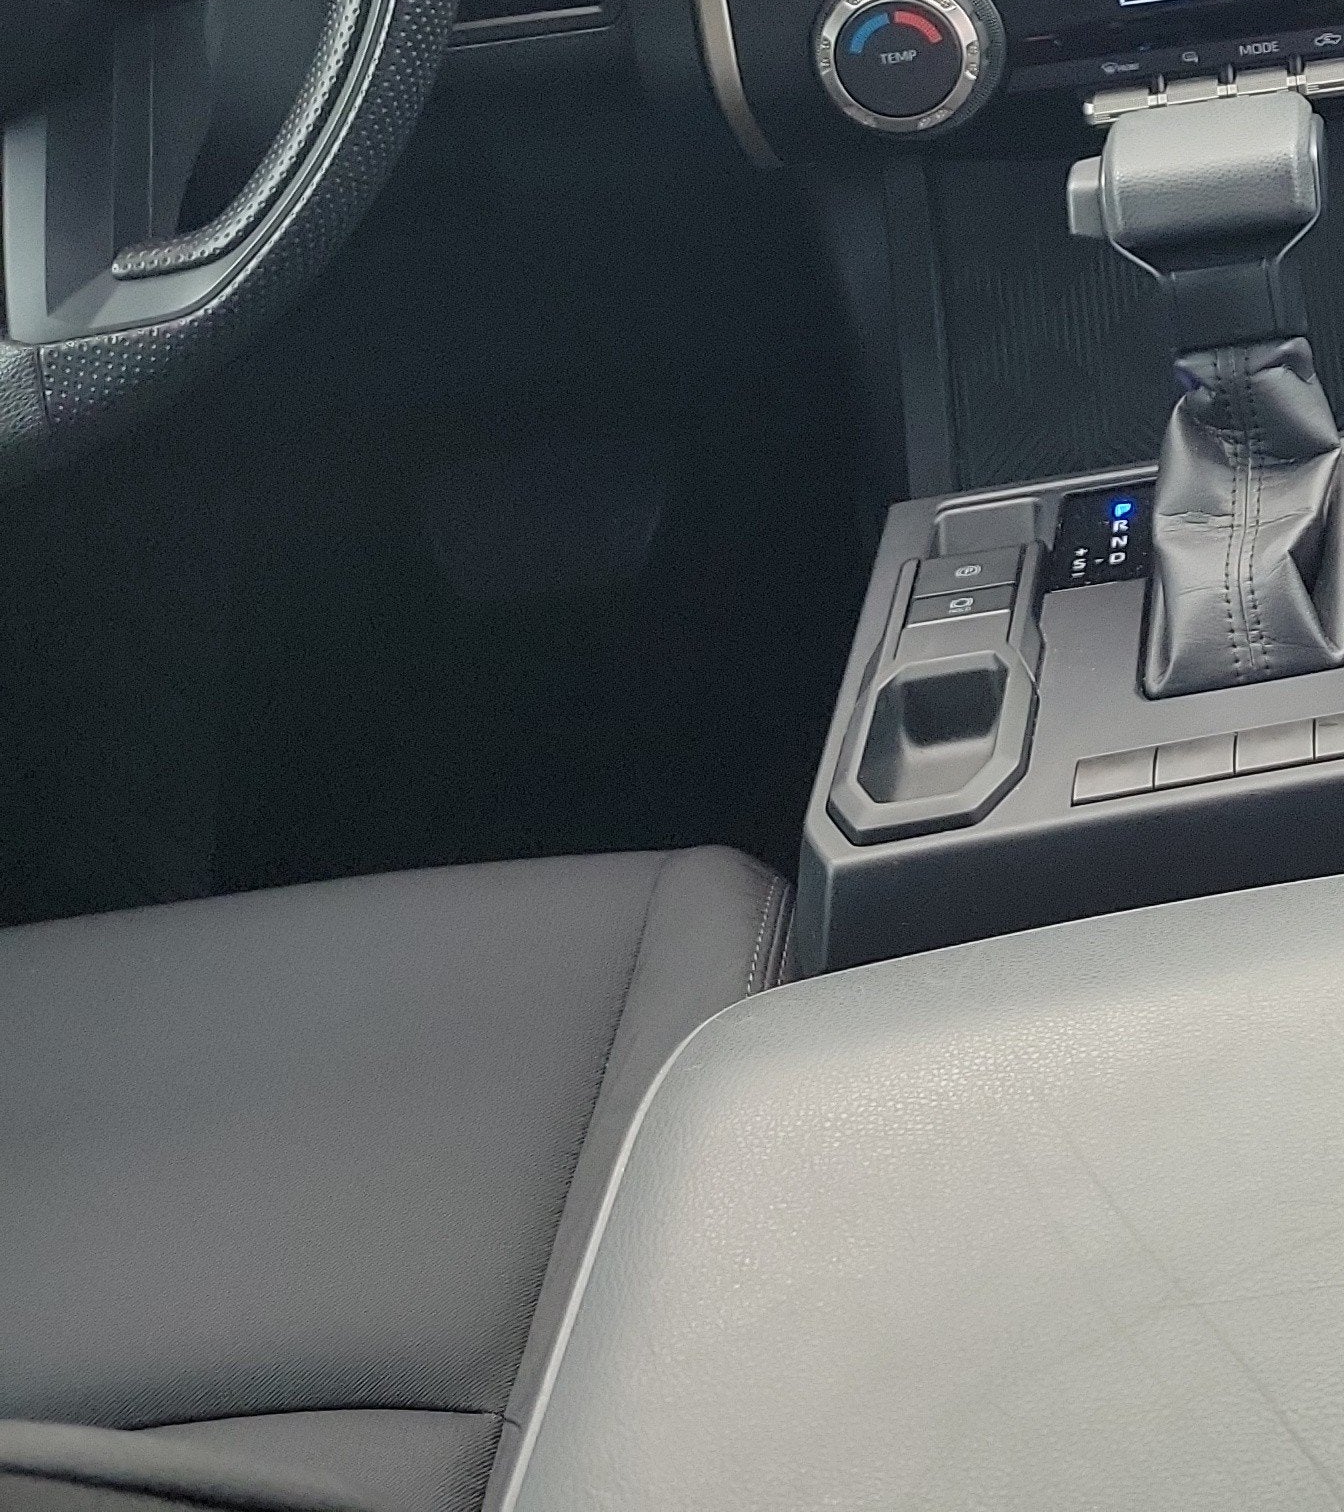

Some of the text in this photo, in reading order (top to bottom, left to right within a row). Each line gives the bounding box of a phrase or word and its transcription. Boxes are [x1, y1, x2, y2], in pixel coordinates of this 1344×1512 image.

[880, 49, 917, 65] TEMP
[1239, 41, 1280, 57] MODE
[1113, 520, 1129, 533] R
[1111, 535, 1128, 548] N
[1072, 552, 1126, 571] S D
